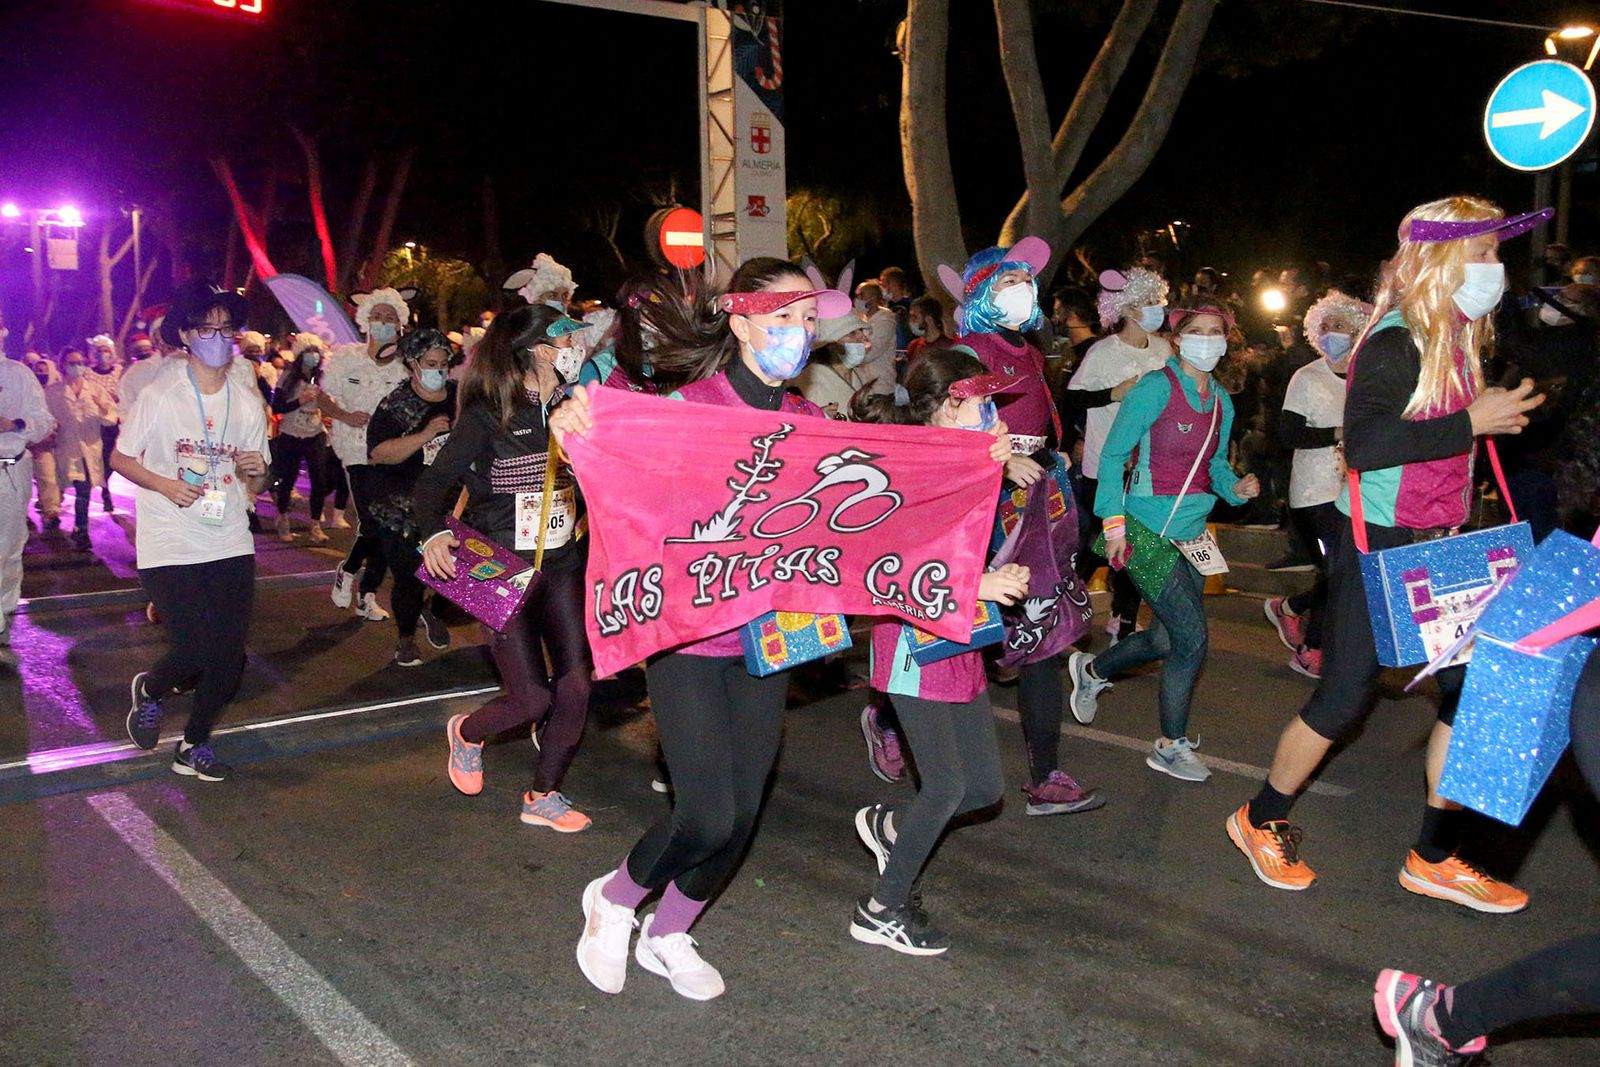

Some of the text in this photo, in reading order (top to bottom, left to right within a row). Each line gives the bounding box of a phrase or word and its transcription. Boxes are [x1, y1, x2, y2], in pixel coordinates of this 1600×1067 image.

[547, 515, 564, 530] 05
[1191, 549, 1211, 563] 186
[593, 543, 957, 636] LAS PITAS C.G.
